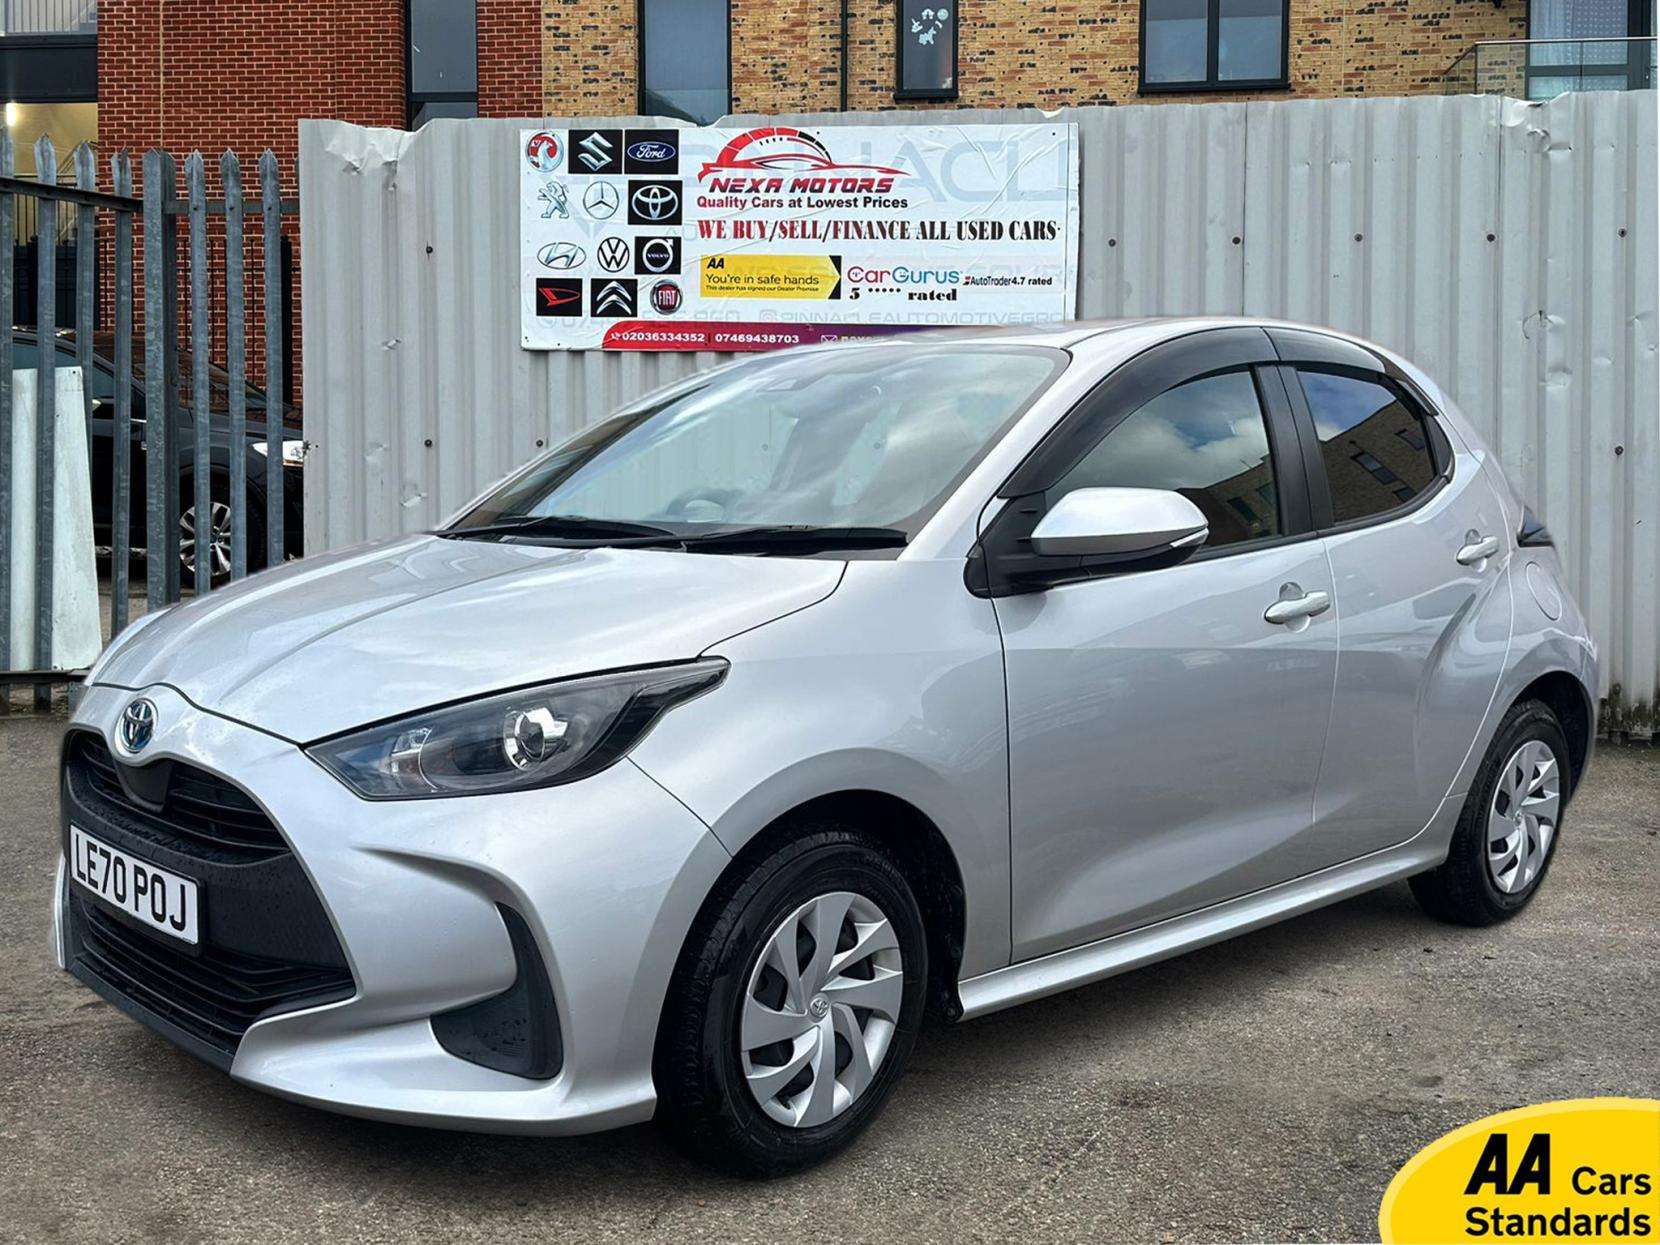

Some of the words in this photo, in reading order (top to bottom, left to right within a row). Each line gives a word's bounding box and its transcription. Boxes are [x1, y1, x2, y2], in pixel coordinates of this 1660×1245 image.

[636, 144, 666, 158] Ford
[708, 177, 784, 194] NEXA
[789, 177, 894, 194] MOTORS
[697, 196, 748, 210] Quality
[751, 196, 784, 208] Cars
[788, 196, 802, 208] at
[807, 196, 858, 208] Lowest
[863, 196, 908, 208] Prices
[697, 219, 727, 240] WE
[732, 219, 911, 243] BUY/SELL/FINANCE
[916, 220, 951, 241] ALL
[956, 220, 1004, 241] USED
[1008, 220, 1057, 241] CARS
[706, 257, 725, 269] AA
[705, 273, 741, 284] You're
[744, 273, 754, 284] in
[757, 274, 781, 285] safe
[784, 274, 819, 285] hands
[847, 266, 960, 284] CarGurus
[1028, 276, 1053, 286] rated
[658, 290, 677, 306] FIAT
[849, 287, 860, 300] 5
[908, 288, 957, 301] rated
[621, 333, 705, 343] 02036334352
[714, 334, 800, 344] 07469438703
[75, 833, 127, 904] LE70
[133, 863, 187, 932] POJ
